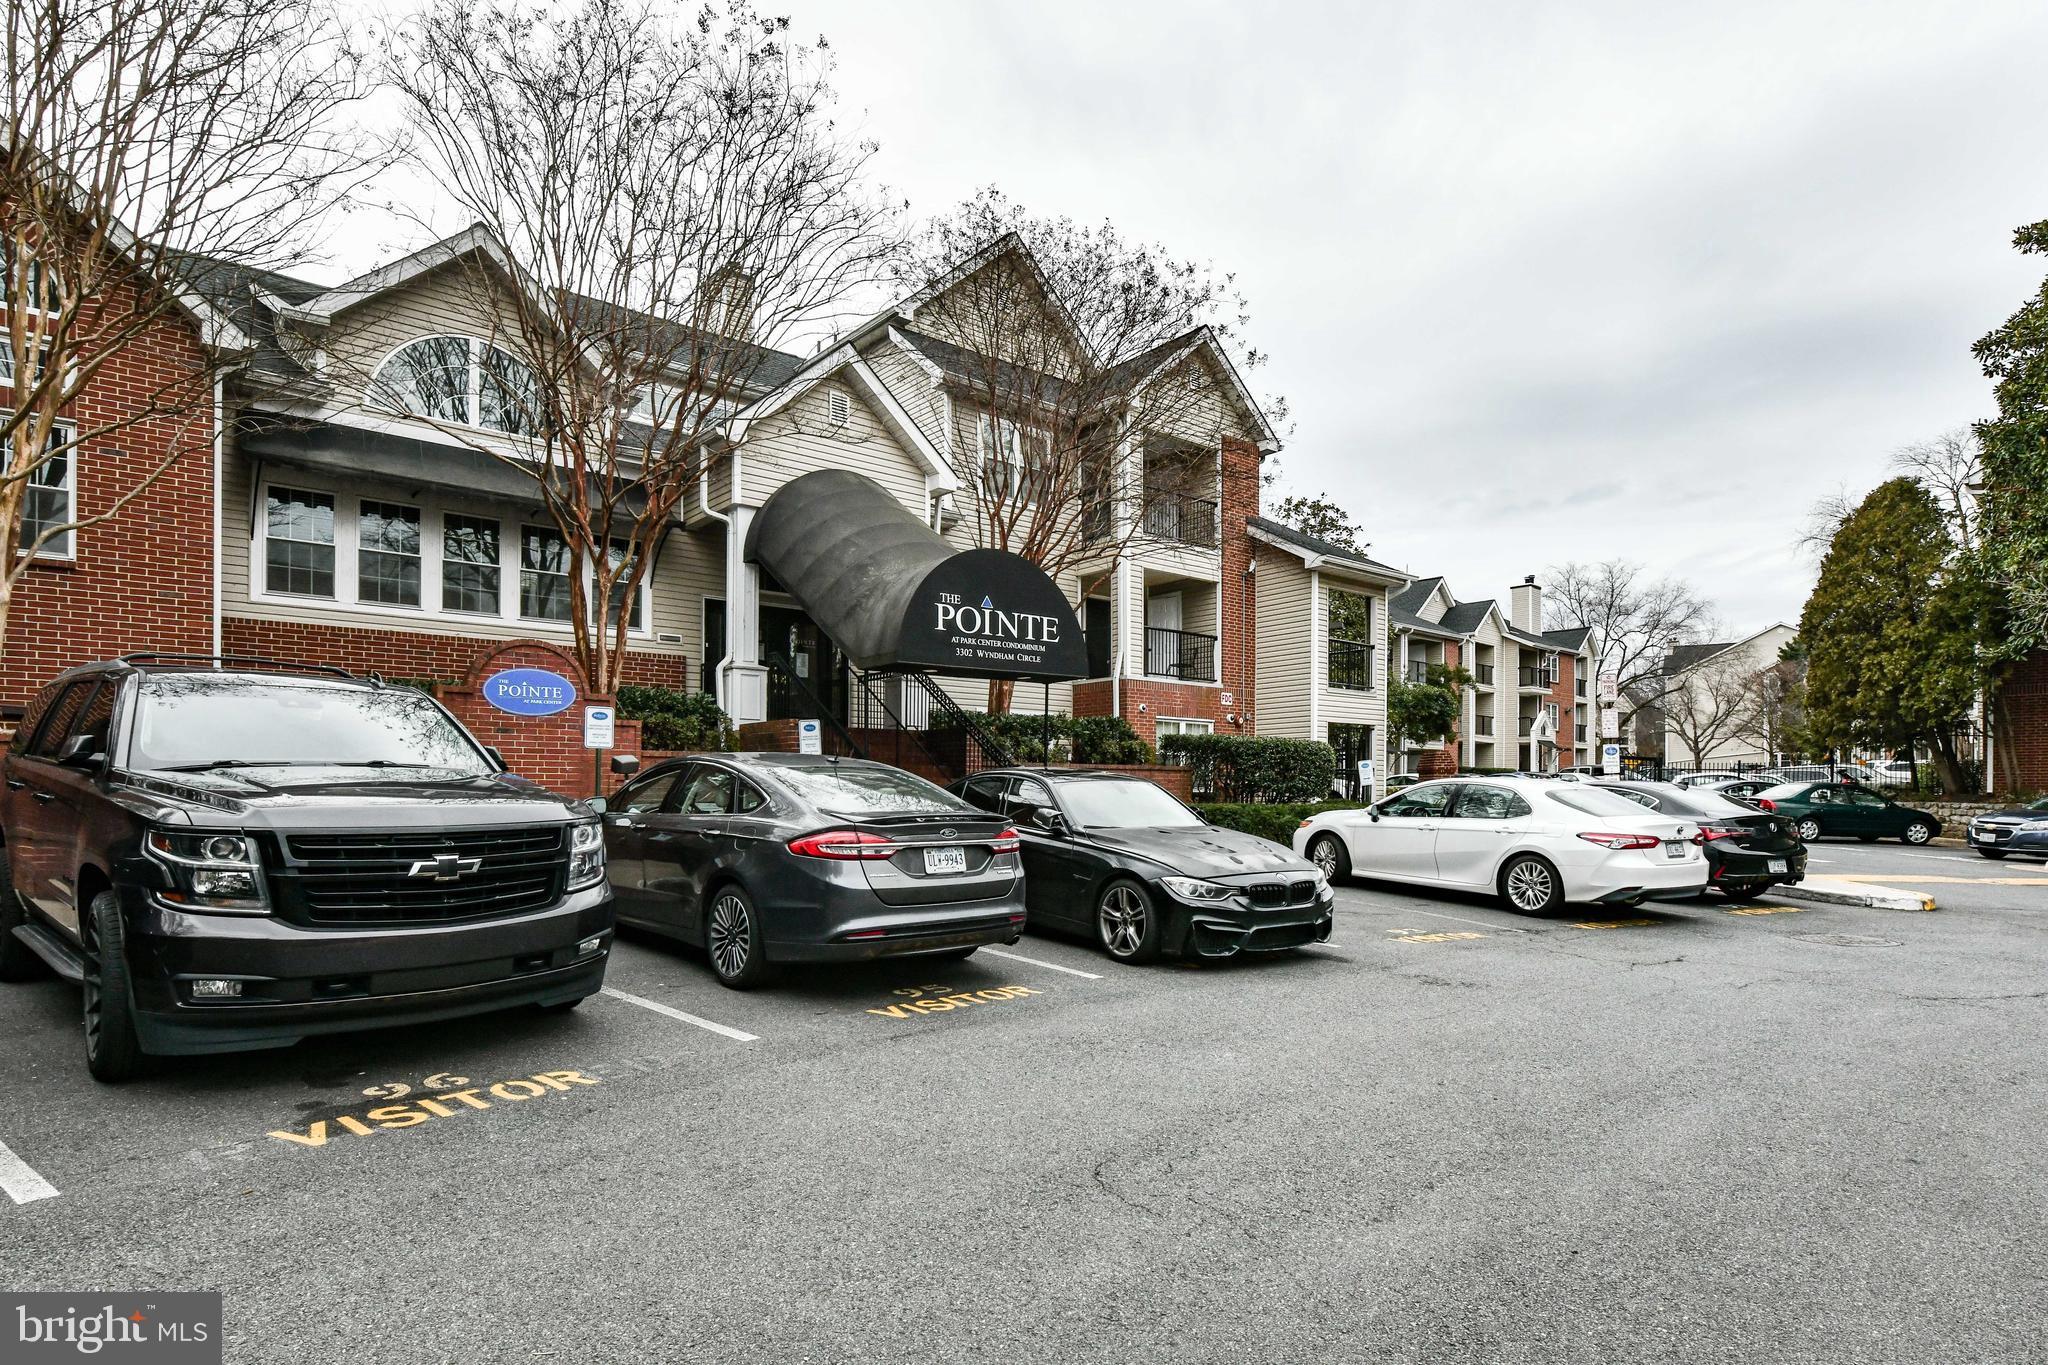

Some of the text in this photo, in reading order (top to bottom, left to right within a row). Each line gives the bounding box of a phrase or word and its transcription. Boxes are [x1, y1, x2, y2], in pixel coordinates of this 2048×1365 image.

[939, 593, 962, 604] THE
[934, 602, 1060, 643] POINTE
[951, 636, 1046, 652] AT PARK CENTER CONDOMINIUM
[955, 647, 973, 657] 3302
[498, 684, 563, 699] POINTE
[892, 984, 953, 998] 95
[865, 985, 1044, 1019] VISITOR
[362, 1072, 470, 1100] 96
[266, 1070, 601, 1147] VISITOR
